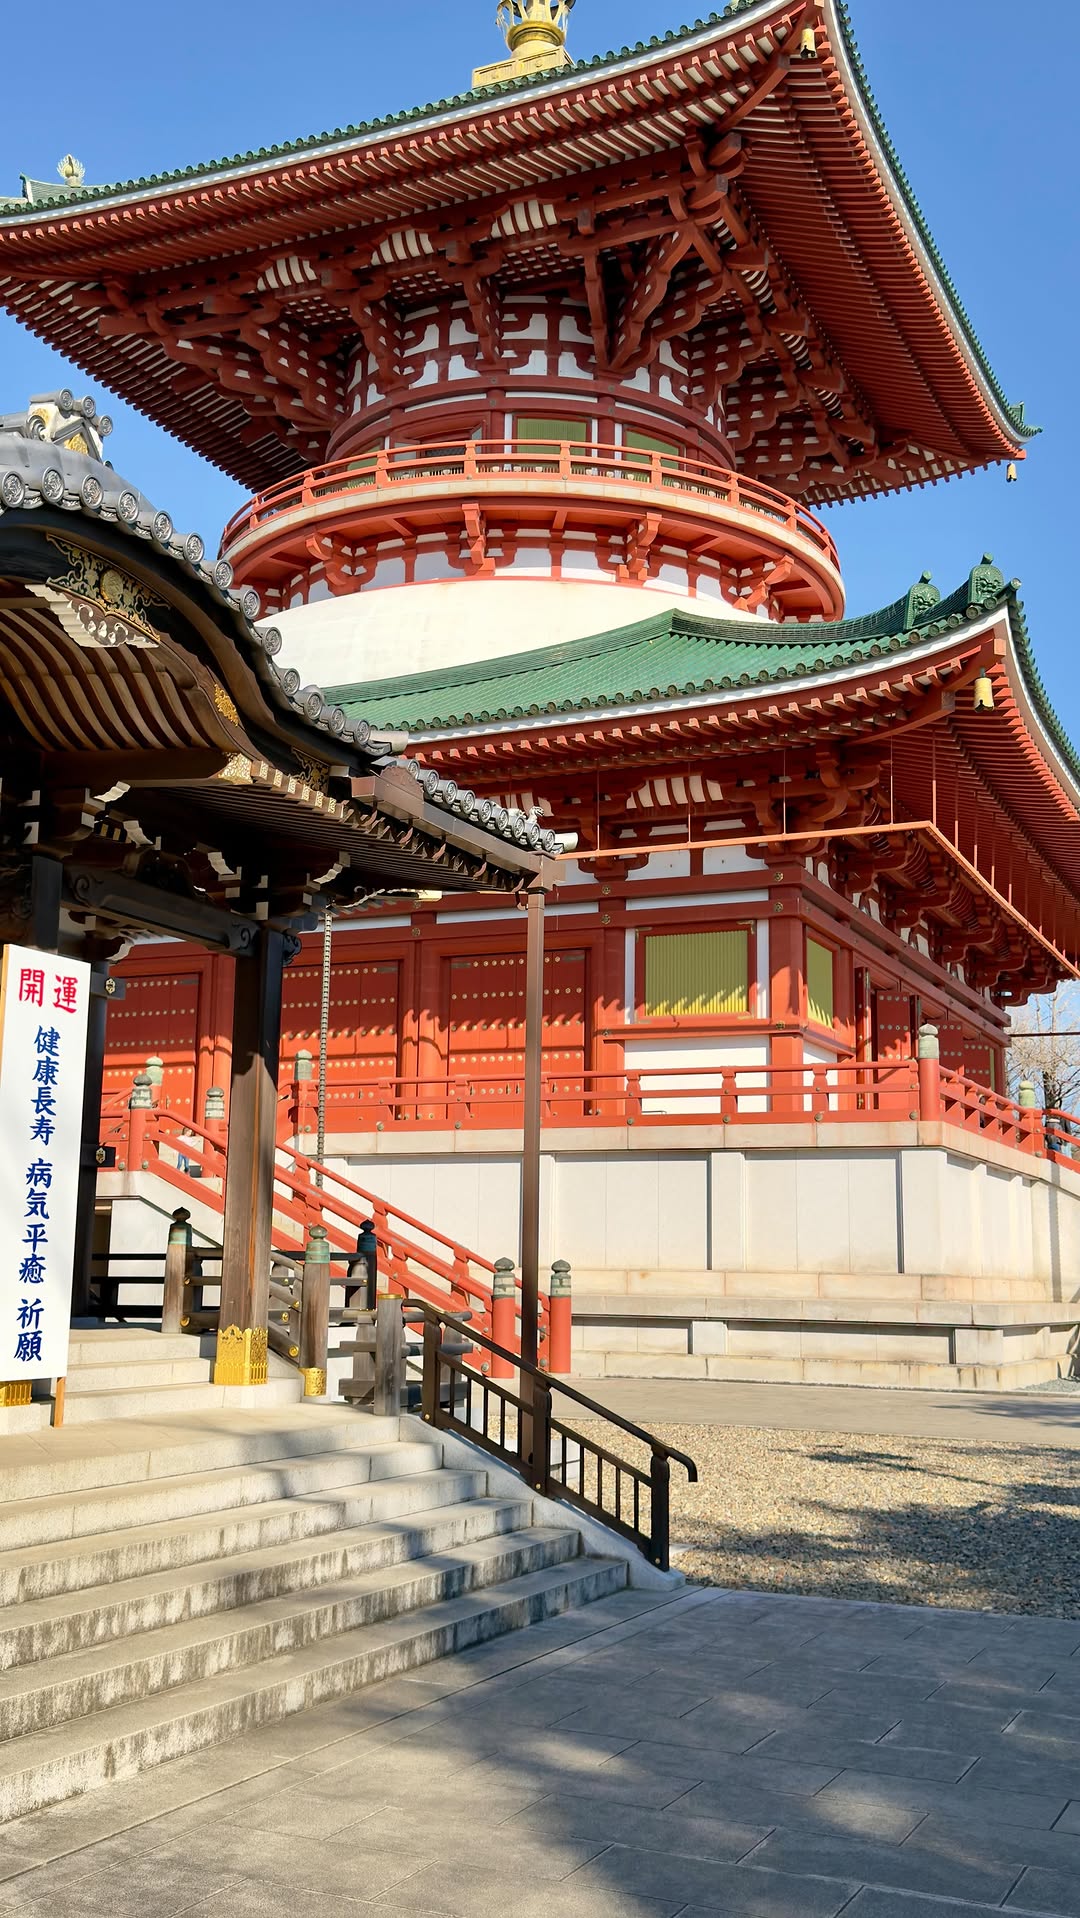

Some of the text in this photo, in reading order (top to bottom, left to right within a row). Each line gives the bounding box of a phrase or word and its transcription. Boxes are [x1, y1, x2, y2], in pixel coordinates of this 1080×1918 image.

[18, 968, 79, 1014] 開運
[14, 1025, 61, 1361] 健康長寿 病気平癒 祈願
